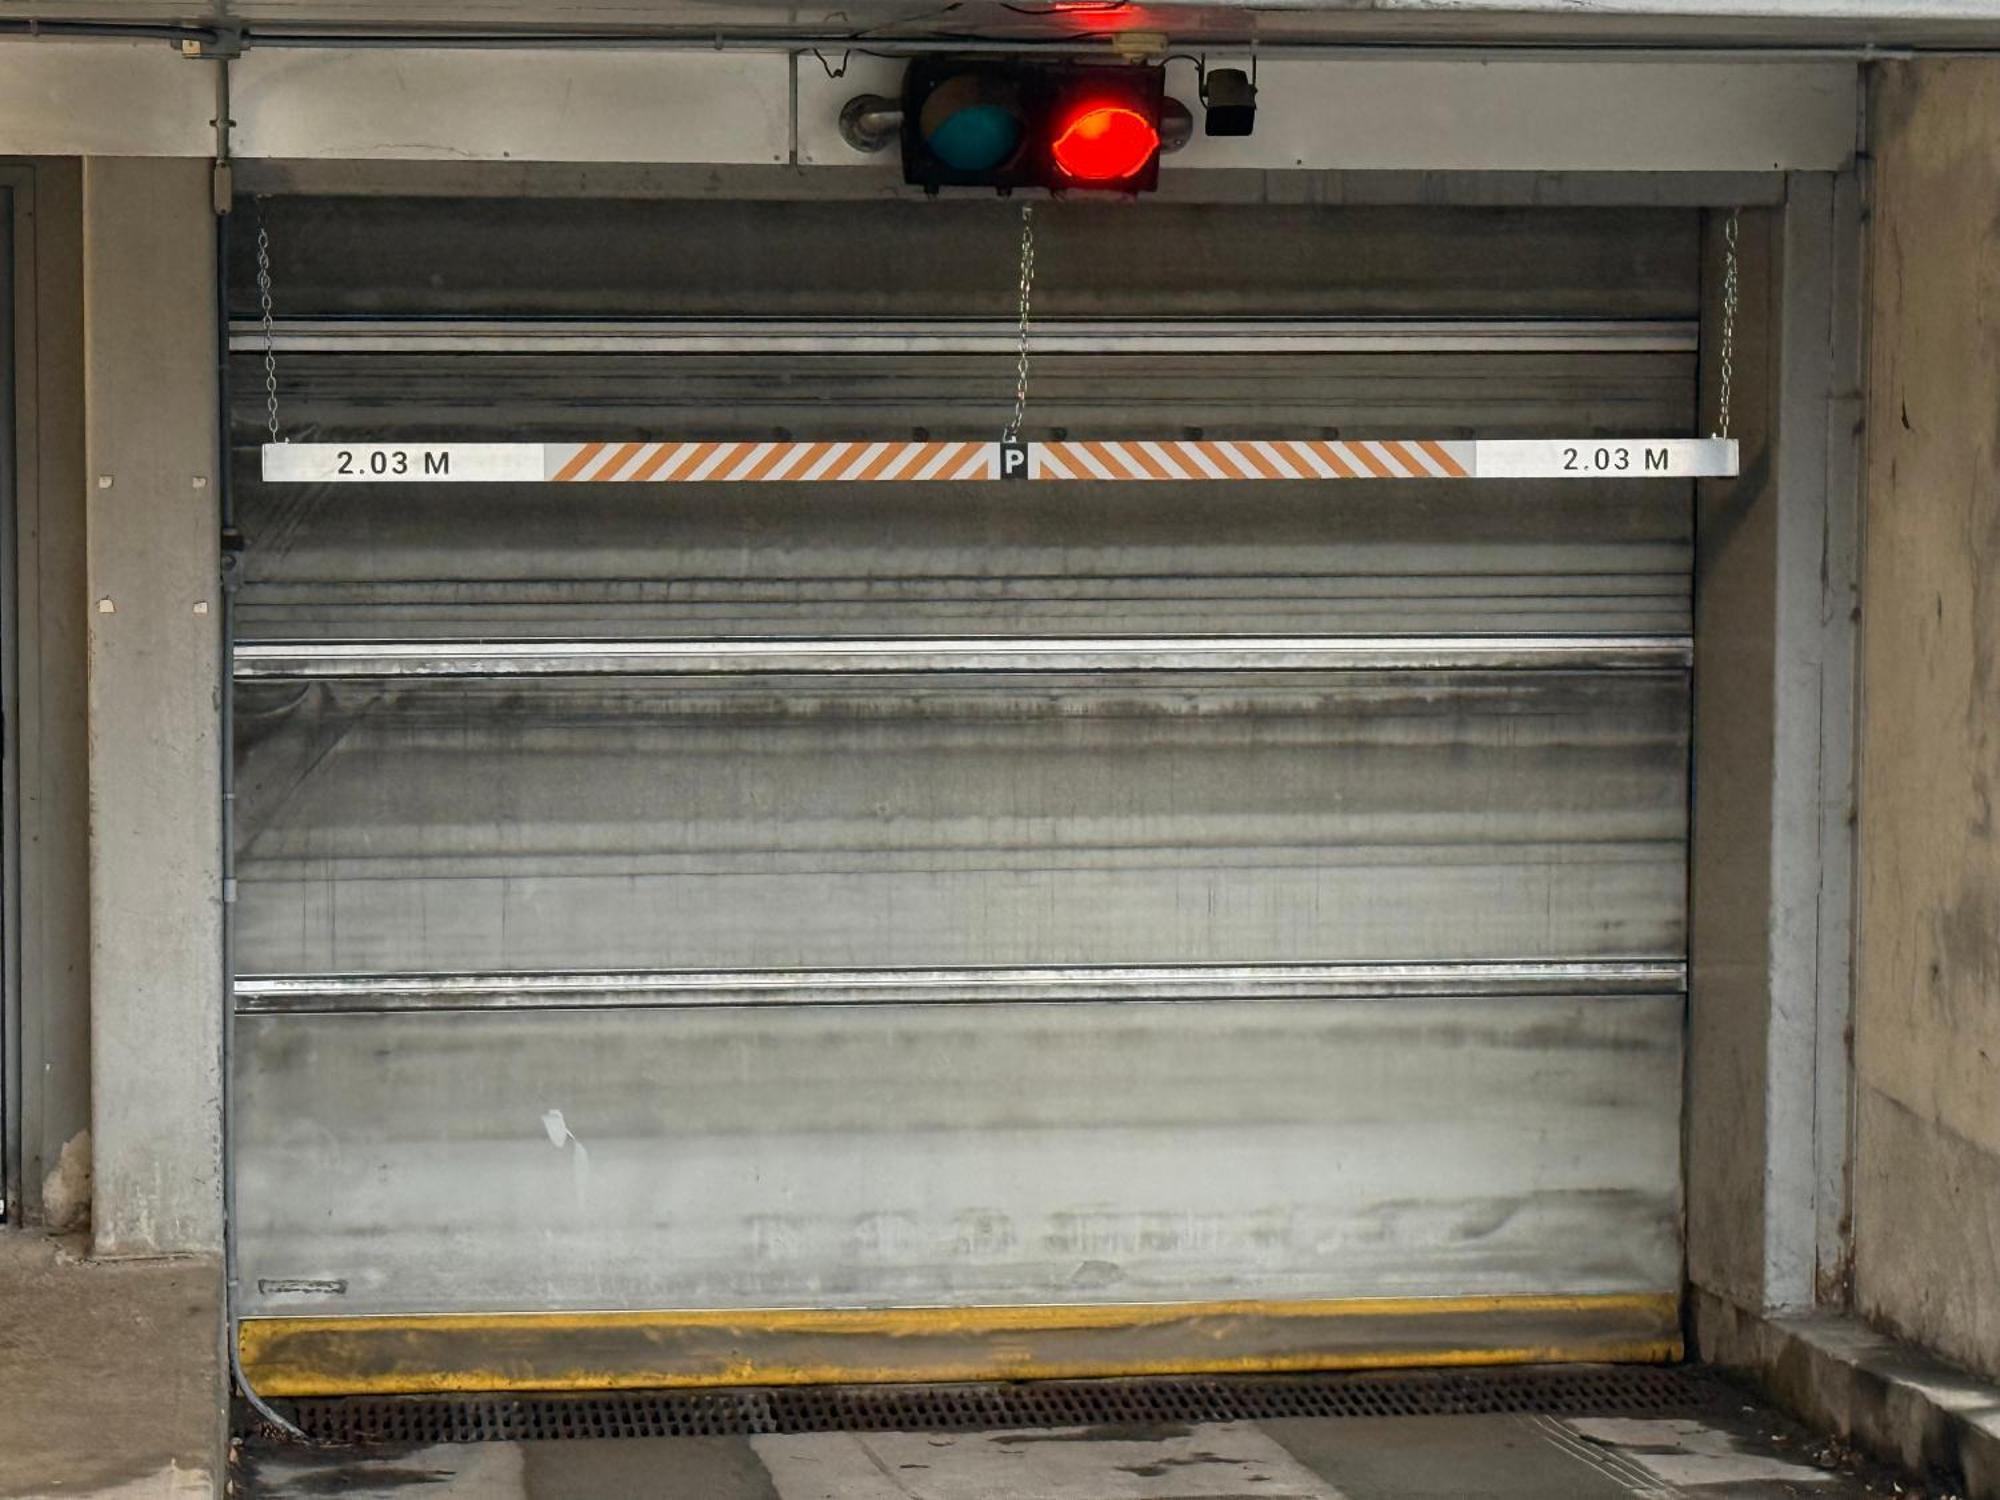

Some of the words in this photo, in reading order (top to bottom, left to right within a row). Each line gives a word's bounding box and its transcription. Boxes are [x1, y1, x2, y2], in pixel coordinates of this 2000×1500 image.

[337, 451, 408, 475] 2.03
[424, 451, 449, 475] M
[1005, 449, 1025, 474] P
[1563, 447, 1629, 471] 2.03
[1645, 447, 1669, 471] M
